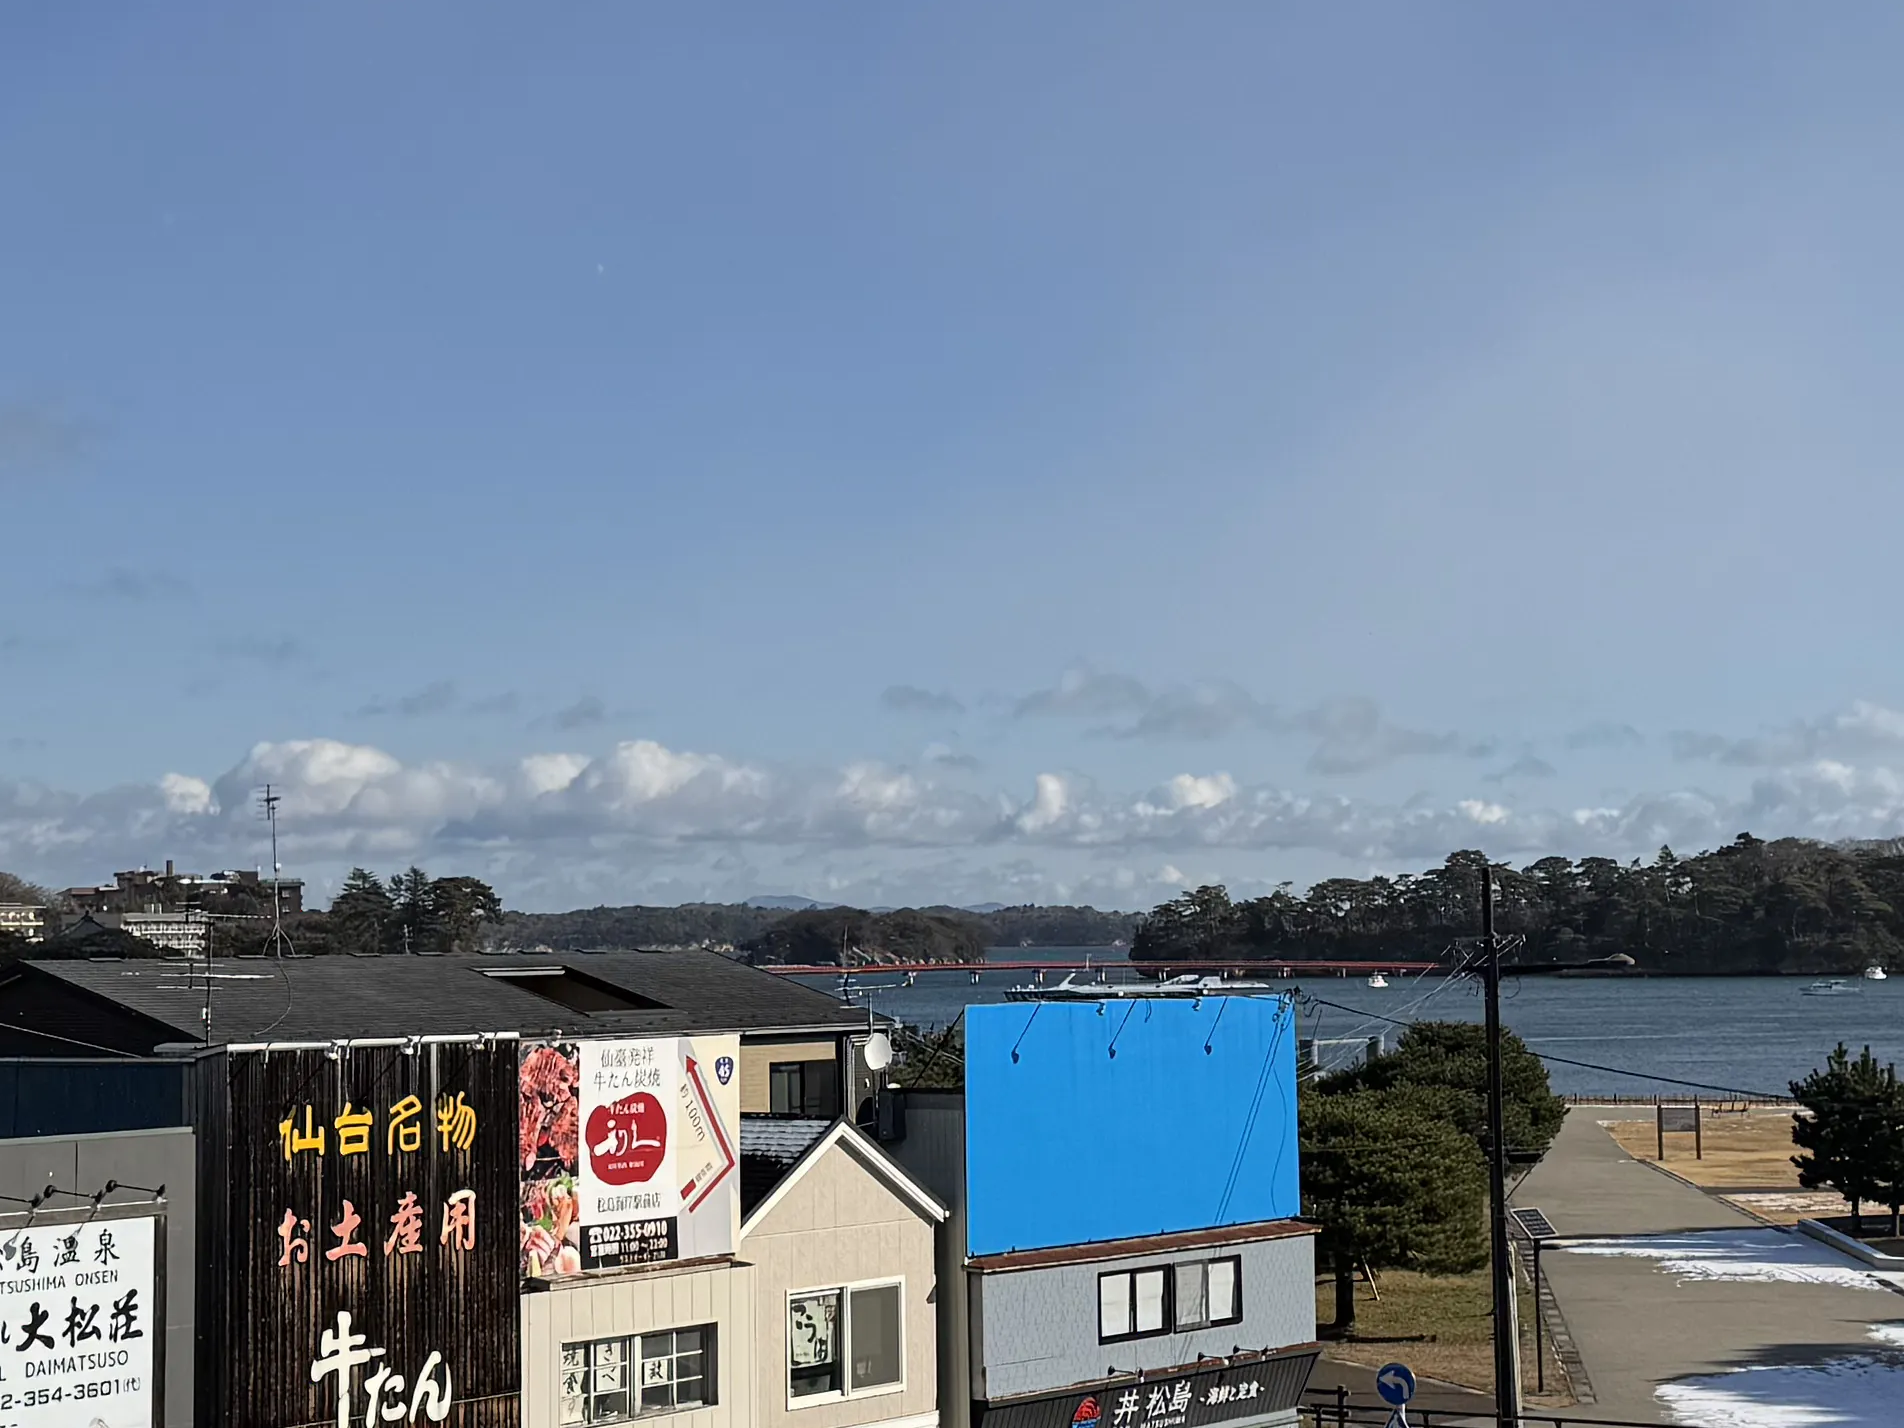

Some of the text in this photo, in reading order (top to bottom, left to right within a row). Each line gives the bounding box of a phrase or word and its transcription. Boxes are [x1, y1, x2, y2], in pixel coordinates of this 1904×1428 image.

[279, 1090, 477, 1161] 仙台名物
[277, 1188, 478, 1267] お土産用
[74, 1269, 119, 1287] ONSEN
[16, 1288, 143, 1352] 大松荘
[25, 1349, 128, 1379] DAIMATSUSO
[1146, 1380, 1192, 1418] 松島
